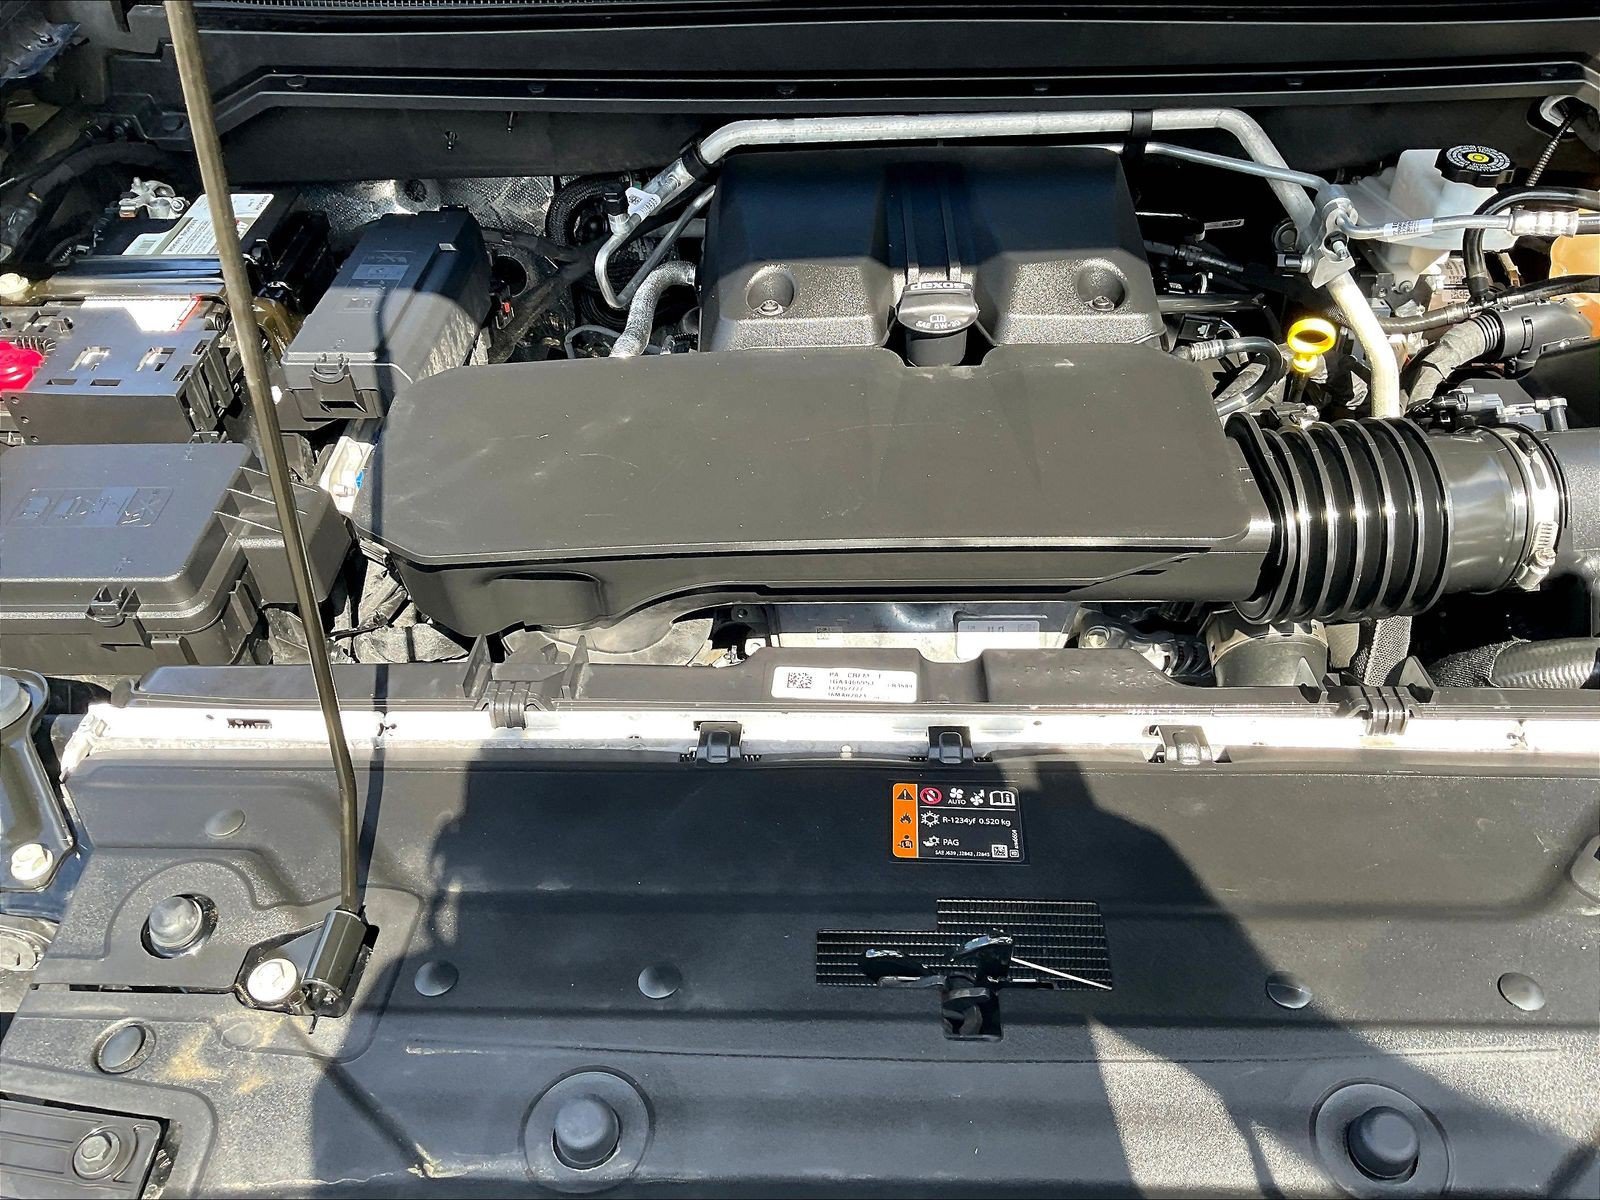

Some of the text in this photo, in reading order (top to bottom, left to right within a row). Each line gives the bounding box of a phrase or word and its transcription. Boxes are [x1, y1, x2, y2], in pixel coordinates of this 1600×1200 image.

[910, 282, 965, 290] dexos
[915, 320, 961, 329] SAE 5W-30
[942, 816, 1011, 827] R-1234yf 0.520 kg
